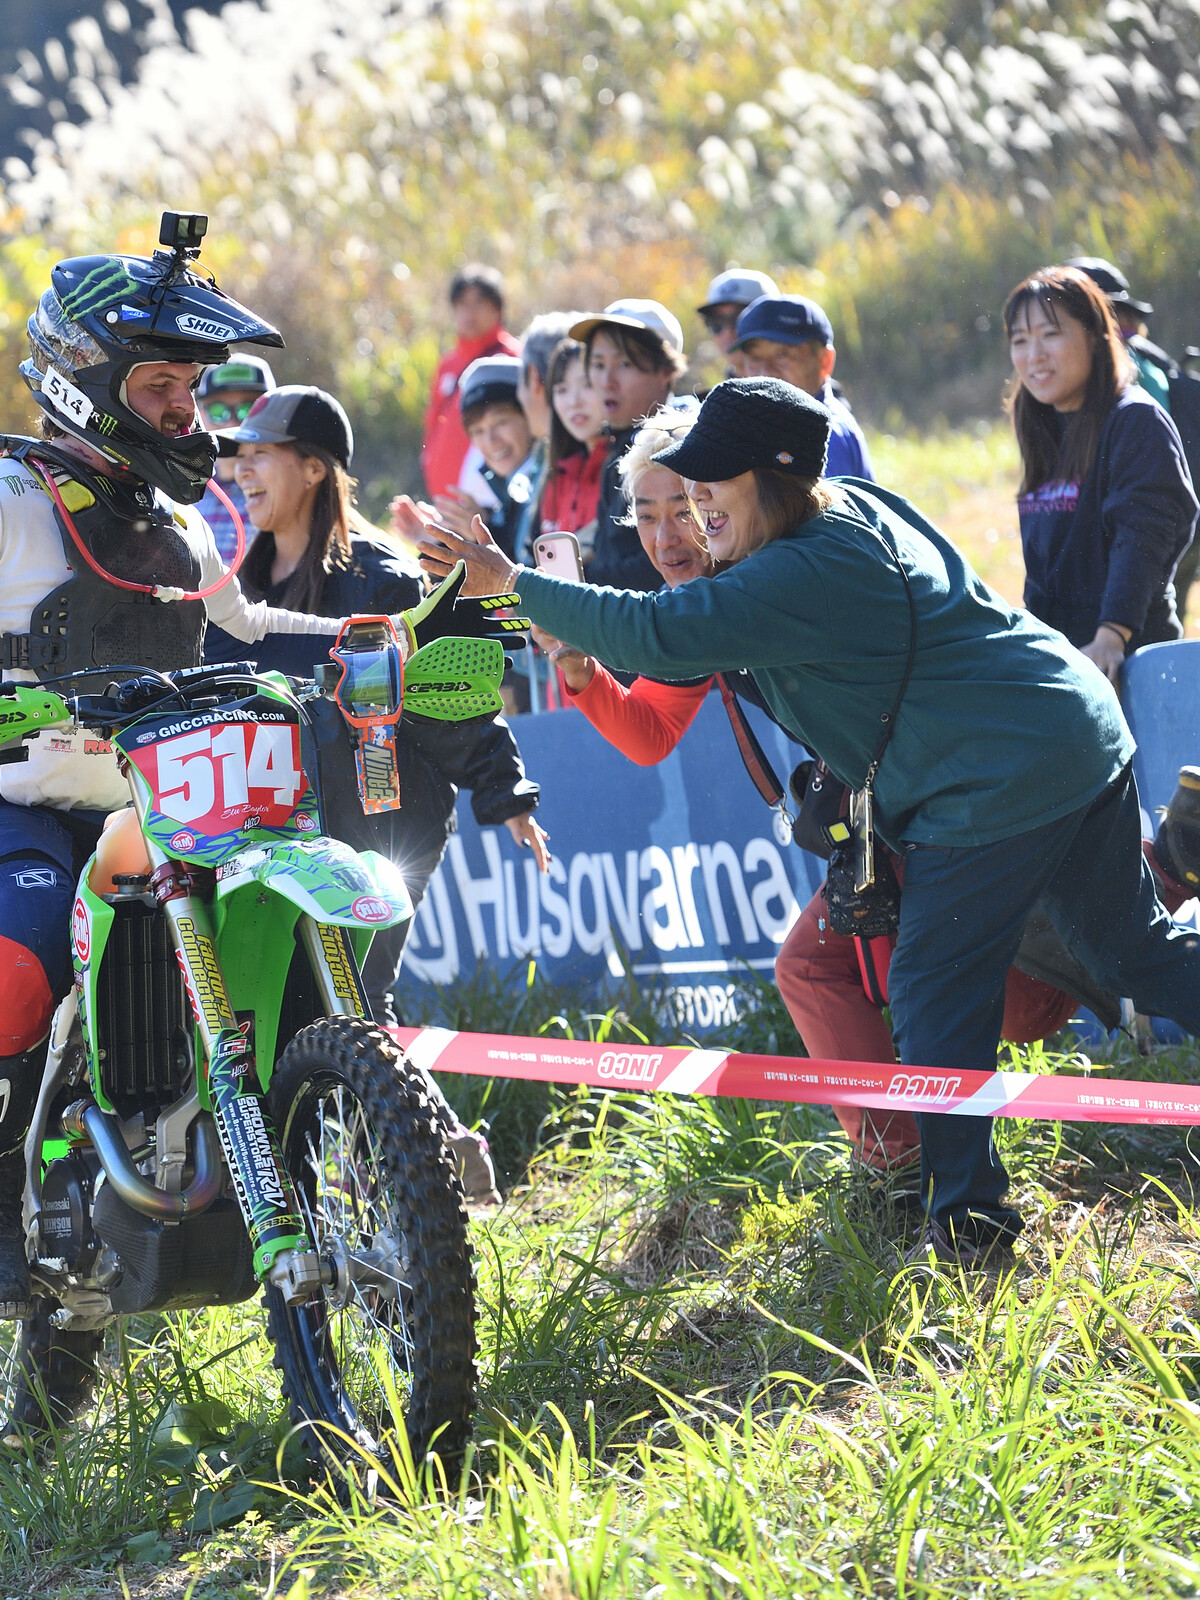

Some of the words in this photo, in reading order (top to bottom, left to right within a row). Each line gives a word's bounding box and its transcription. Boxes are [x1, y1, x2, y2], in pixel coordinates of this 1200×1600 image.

[184, 317, 230, 338] SHOEI
[48, 376, 83, 415] 514
[404, 681, 472, 694] CERBIS
[158, 710, 286, 738] GNCCRACING.COM
[84, 739, 113, 754] RK
[156, 725, 301, 824] 514
[453, 830, 802, 977] Husqvarna
[176, 917, 223, 1035] Connection
[196, 934, 232, 1020] Factory
[597, 1051, 664, 1082] JNCC
[886, 1073, 962, 1105] JNCC
[237, 1097, 265, 1170] SUPERSTORE
[245, 1096, 275, 1168] BROWN'S
[215, 1111, 254, 1221] DUNLOP
[41, 1197, 70, 1211] Kawasaki
[256, 1166, 288, 1208] RV
[43, 1216, 72, 1230] HINSON
